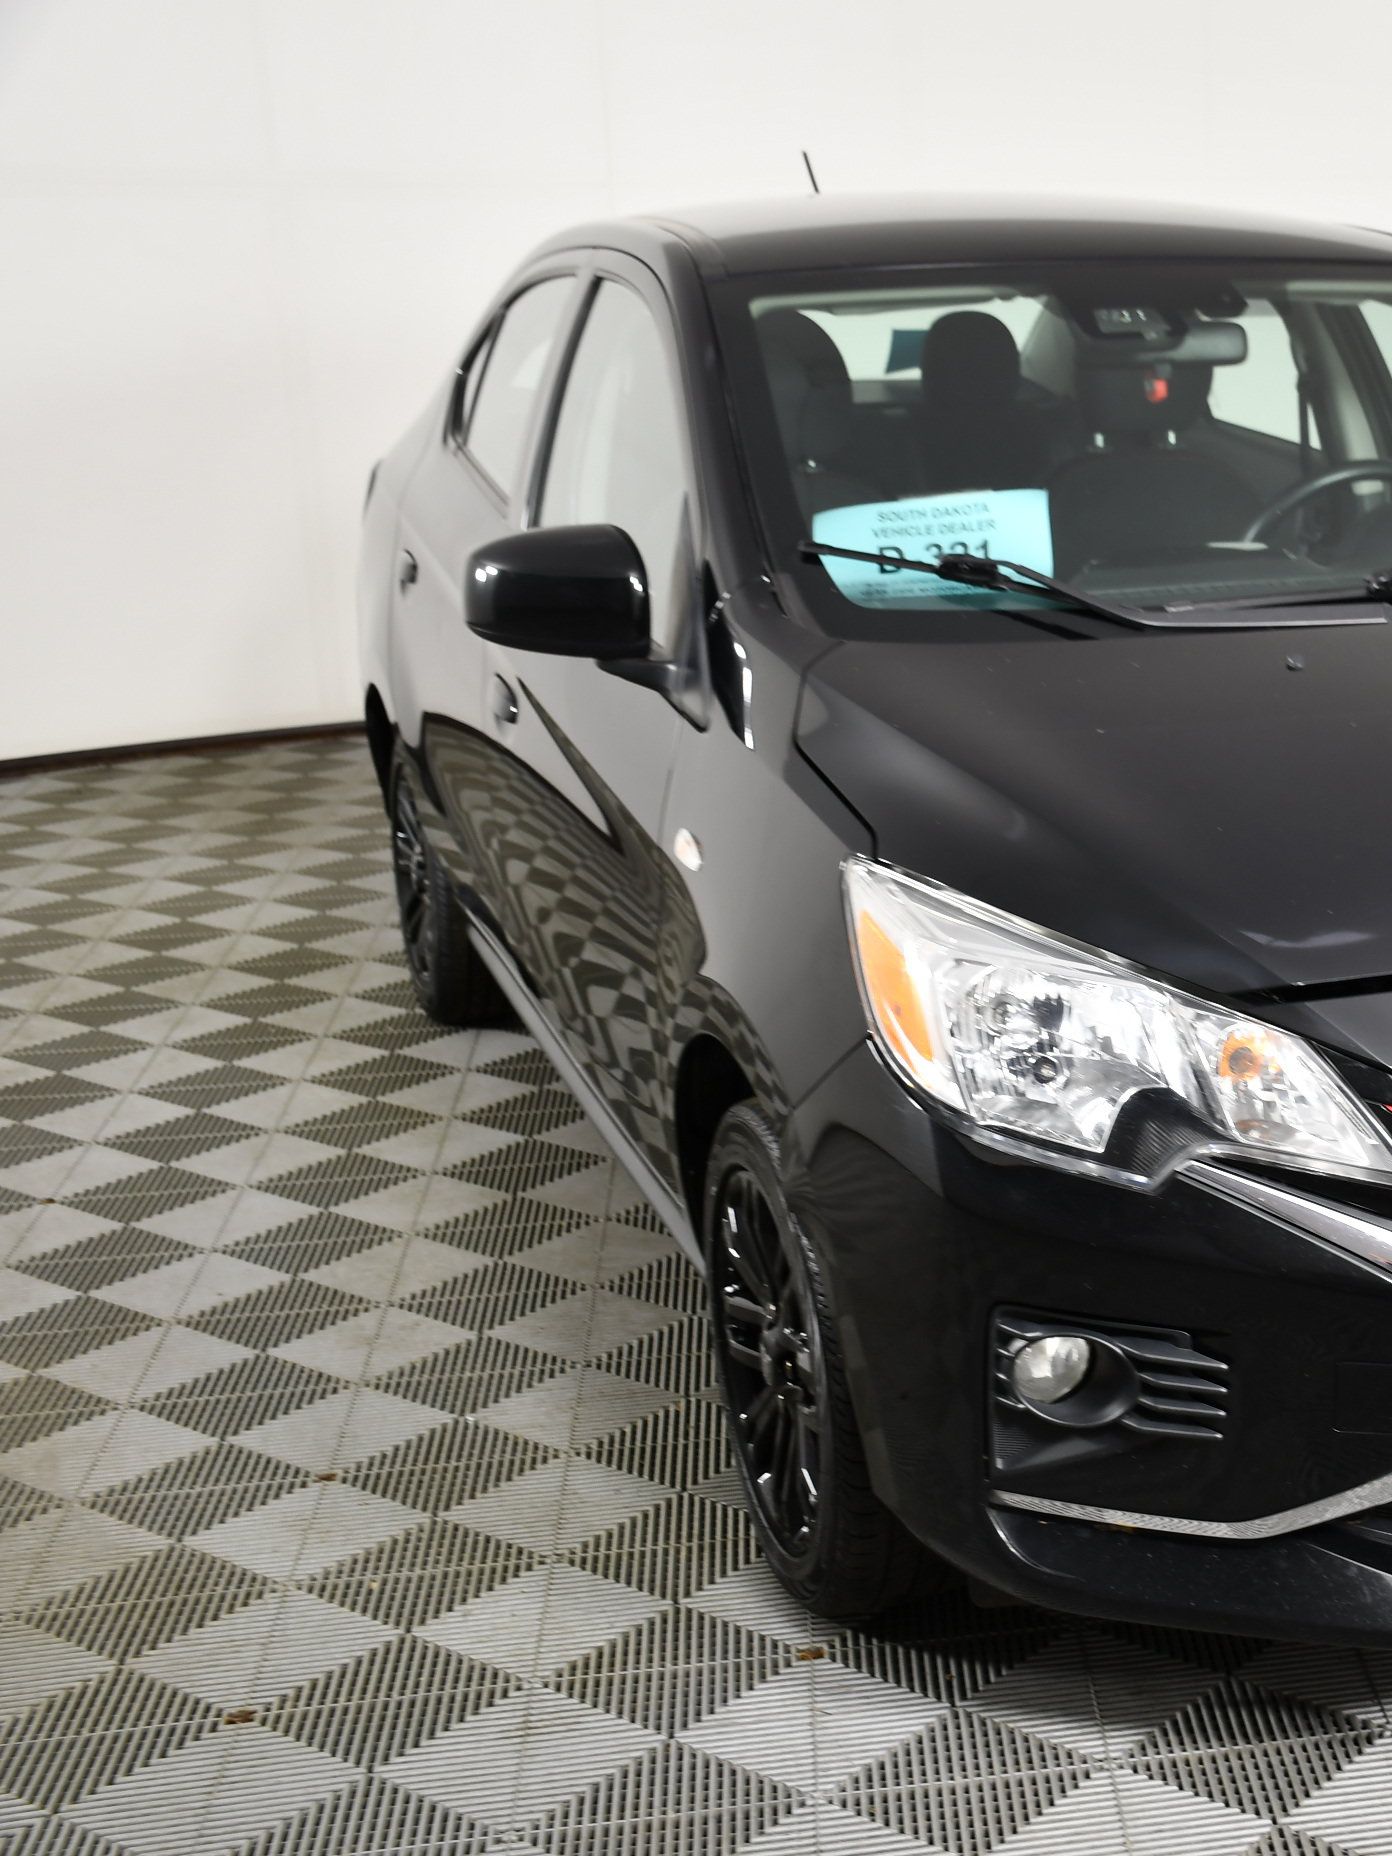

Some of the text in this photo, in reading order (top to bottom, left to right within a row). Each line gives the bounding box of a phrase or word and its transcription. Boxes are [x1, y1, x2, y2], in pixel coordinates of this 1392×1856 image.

[877, 503, 989, 522] SOUTH DAKOTA
[872, 519, 996, 538] VEHICLE DEALER
